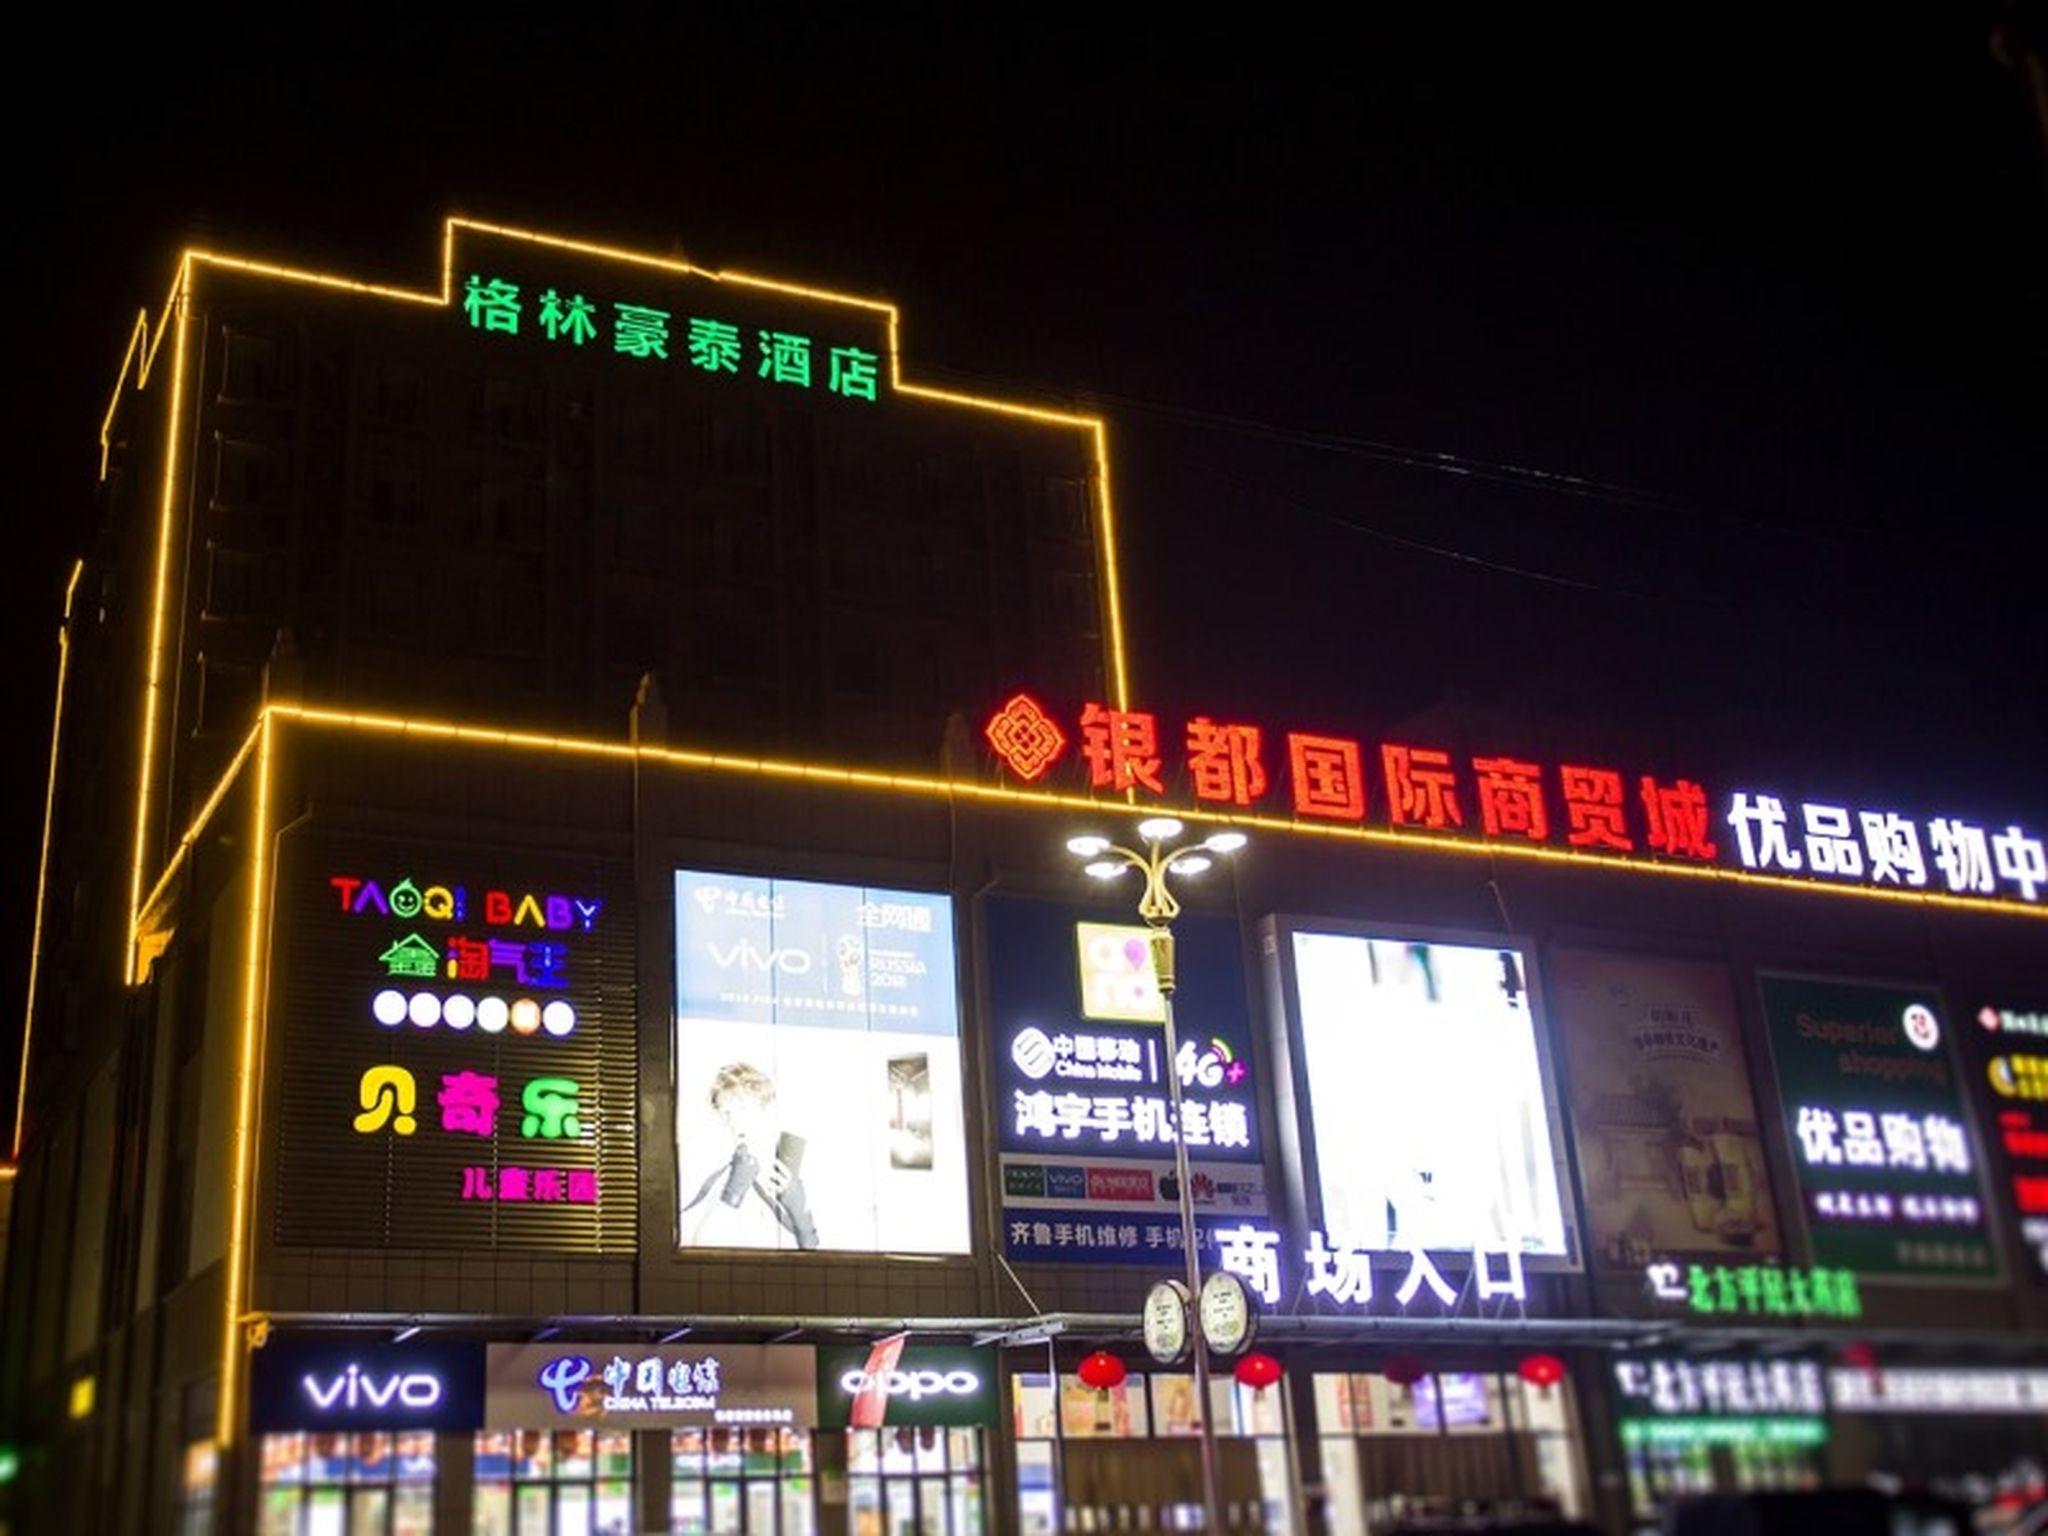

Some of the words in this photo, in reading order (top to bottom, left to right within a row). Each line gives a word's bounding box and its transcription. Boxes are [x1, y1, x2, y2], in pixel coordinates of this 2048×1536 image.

[464, 274, 878, 402] 格林豪泰酒店
[1081, 702, 1717, 859] 银都国际商贸城
[1727, 793, 2048, 901] 优品购物中
[330, 876, 467, 922] TAOQI
[485, 889, 604, 932] BABY
[353, 1065, 582, 1137] 贝奇乐
[1798, 1107, 1972, 1173] 优品购物
[1011, 1222, 1138, 1248] 齐鲁手机维修
[1214, 1225, 1527, 1307] 商场入口
[303, 1364, 440, 1408] vivo
[602, 1396, 649, 1410] CHINA
[603, 1356, 720, 1398] 中国电信
